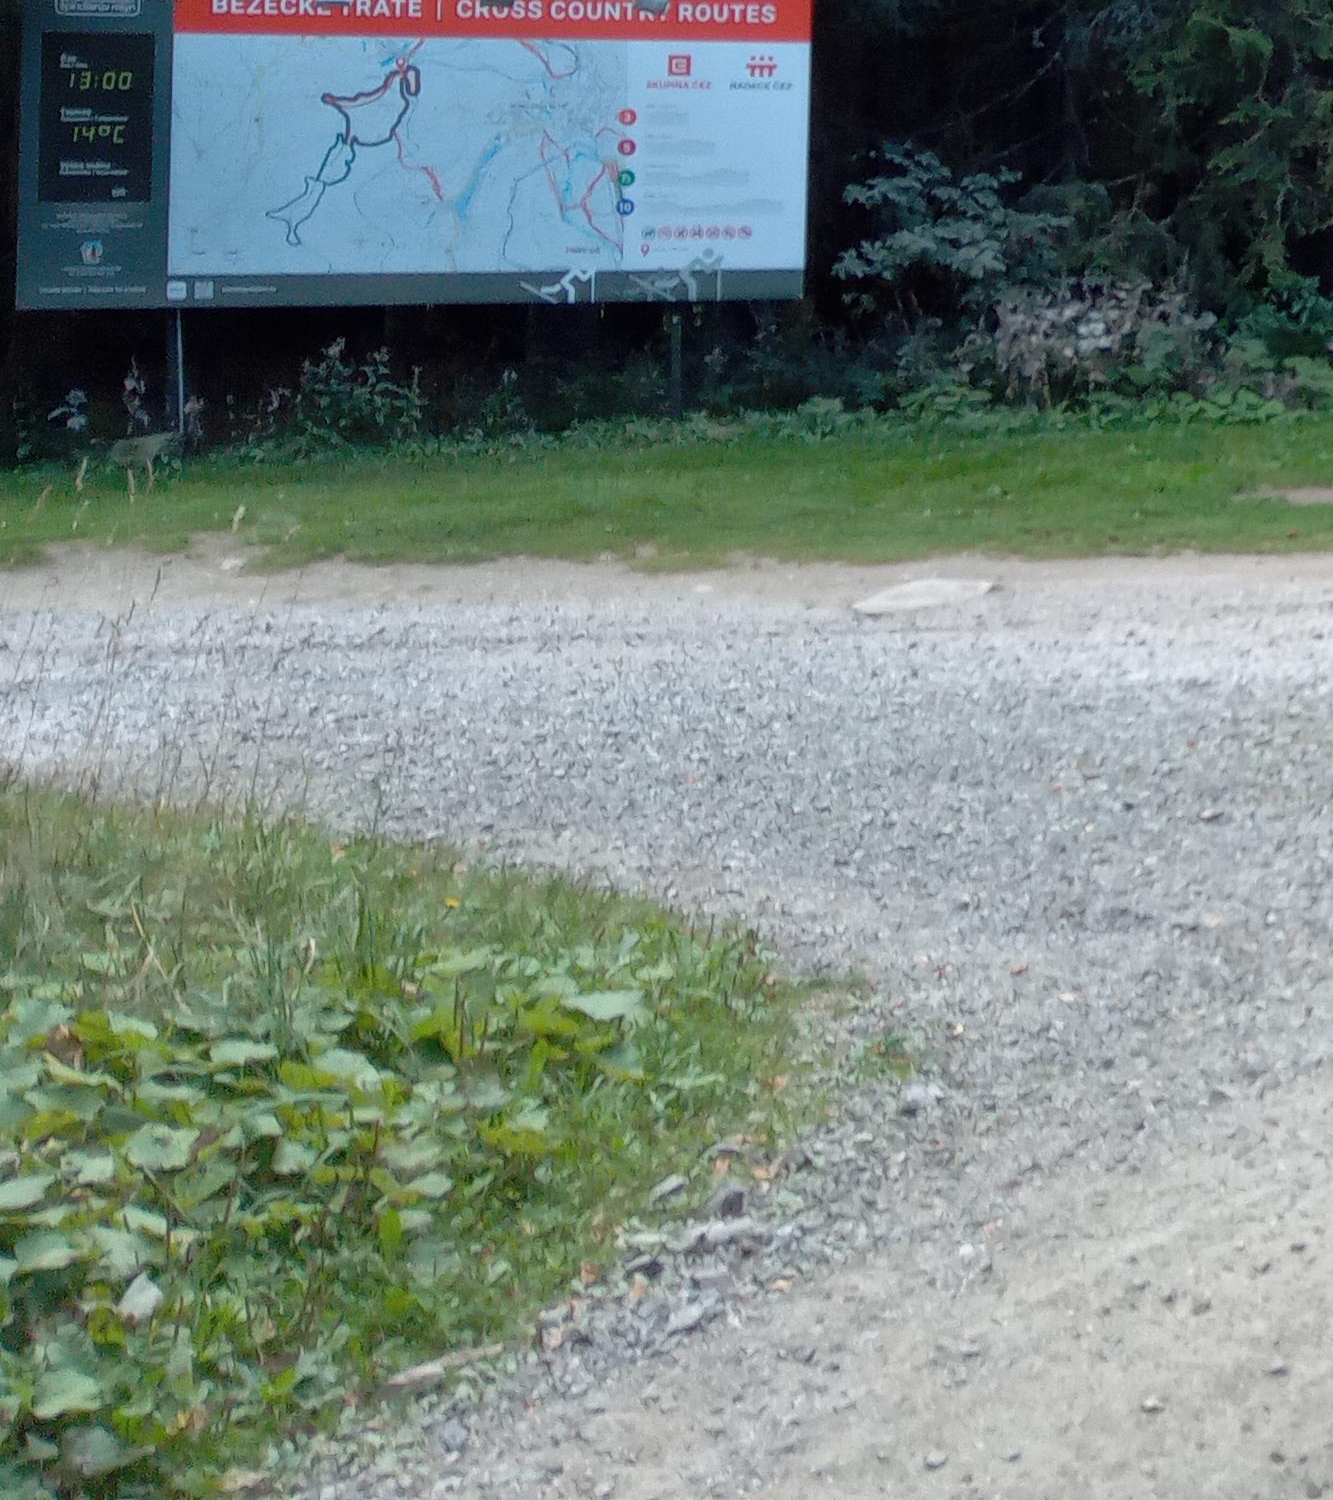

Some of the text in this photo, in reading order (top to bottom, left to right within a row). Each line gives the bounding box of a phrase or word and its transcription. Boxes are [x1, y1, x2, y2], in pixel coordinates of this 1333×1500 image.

[678, 3, 777, 25] ROUTES
[69, 71, 134, 91] 13:00
[73, 125, 126, 145] 14°C
